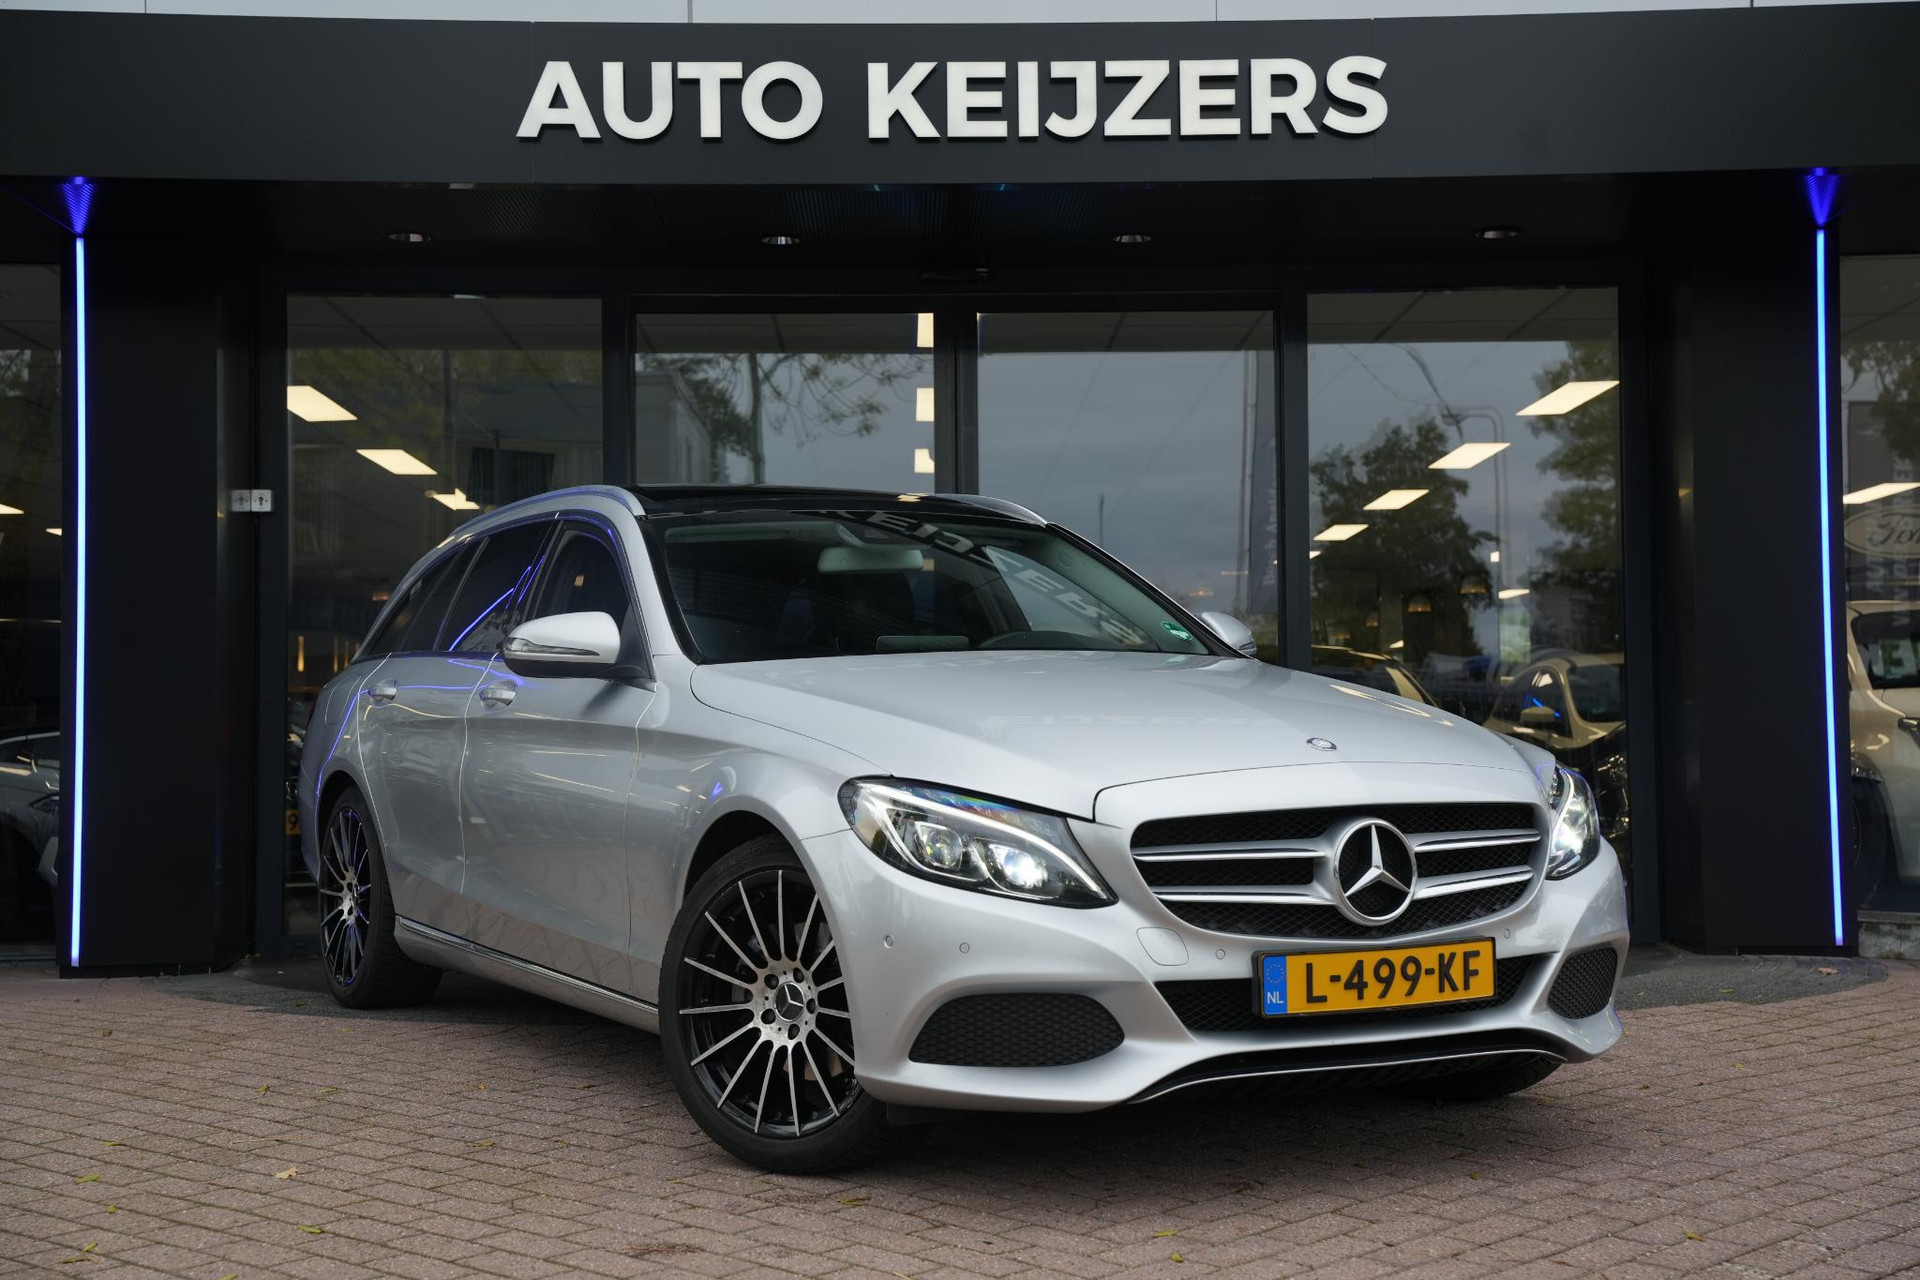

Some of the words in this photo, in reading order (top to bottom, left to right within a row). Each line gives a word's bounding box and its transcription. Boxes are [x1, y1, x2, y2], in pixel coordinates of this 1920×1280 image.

[516, 61, 823, 140] AUTO
[868, 56, 1388, 139] KEIJZERS
[1267, 991, 1284, 1004] NL
[1306, 950, 1481, 1005] L-499-KF
